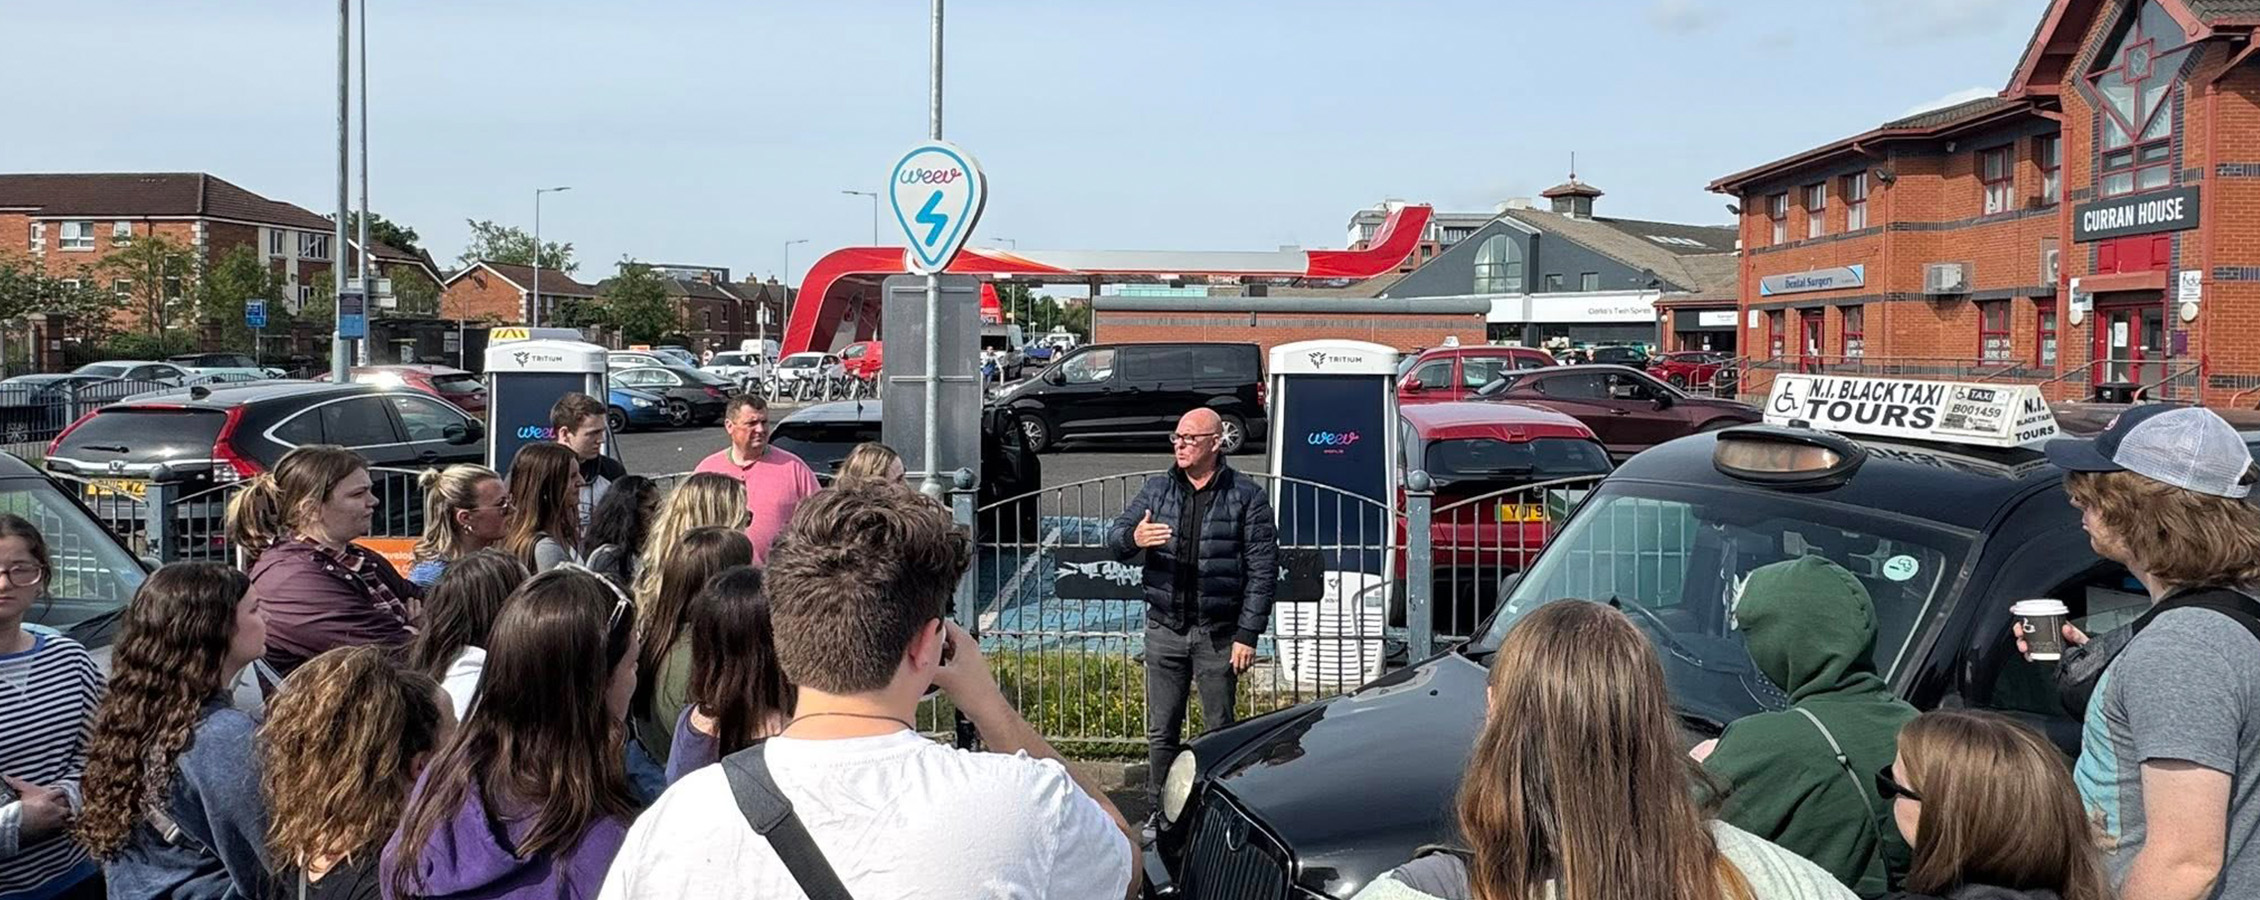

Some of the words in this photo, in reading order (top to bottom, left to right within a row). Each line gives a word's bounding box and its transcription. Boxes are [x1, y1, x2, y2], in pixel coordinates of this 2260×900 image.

[900, 168, 962, 184] weev
[2084, 205, 2134, 232] CURRAN
[2138, 197, 2184, 225] HOUSE
[1785, 278, 1806, 289] Dental
[1807, 277, 1833, 288] Surgery
[1809, 379, 1835, 399] N.I.
[1839, 380, 1896, 403] BLACK
[1900, 384, 1945, 406] TAXI
[1971, 390, 1994, 400] TAXI
[1952, 404, 2001, 418] B001459
[2024, 397, 2045, 414] N.I.
[1807, 399, 1935, 429] TOURS
[2016, 416, 2036, 427] BLACK
[2037, 413, 2052, 422] TAXI
[1308, 431, 1359, 445] weev
[2015, 426, 2055, 441] TOURS
